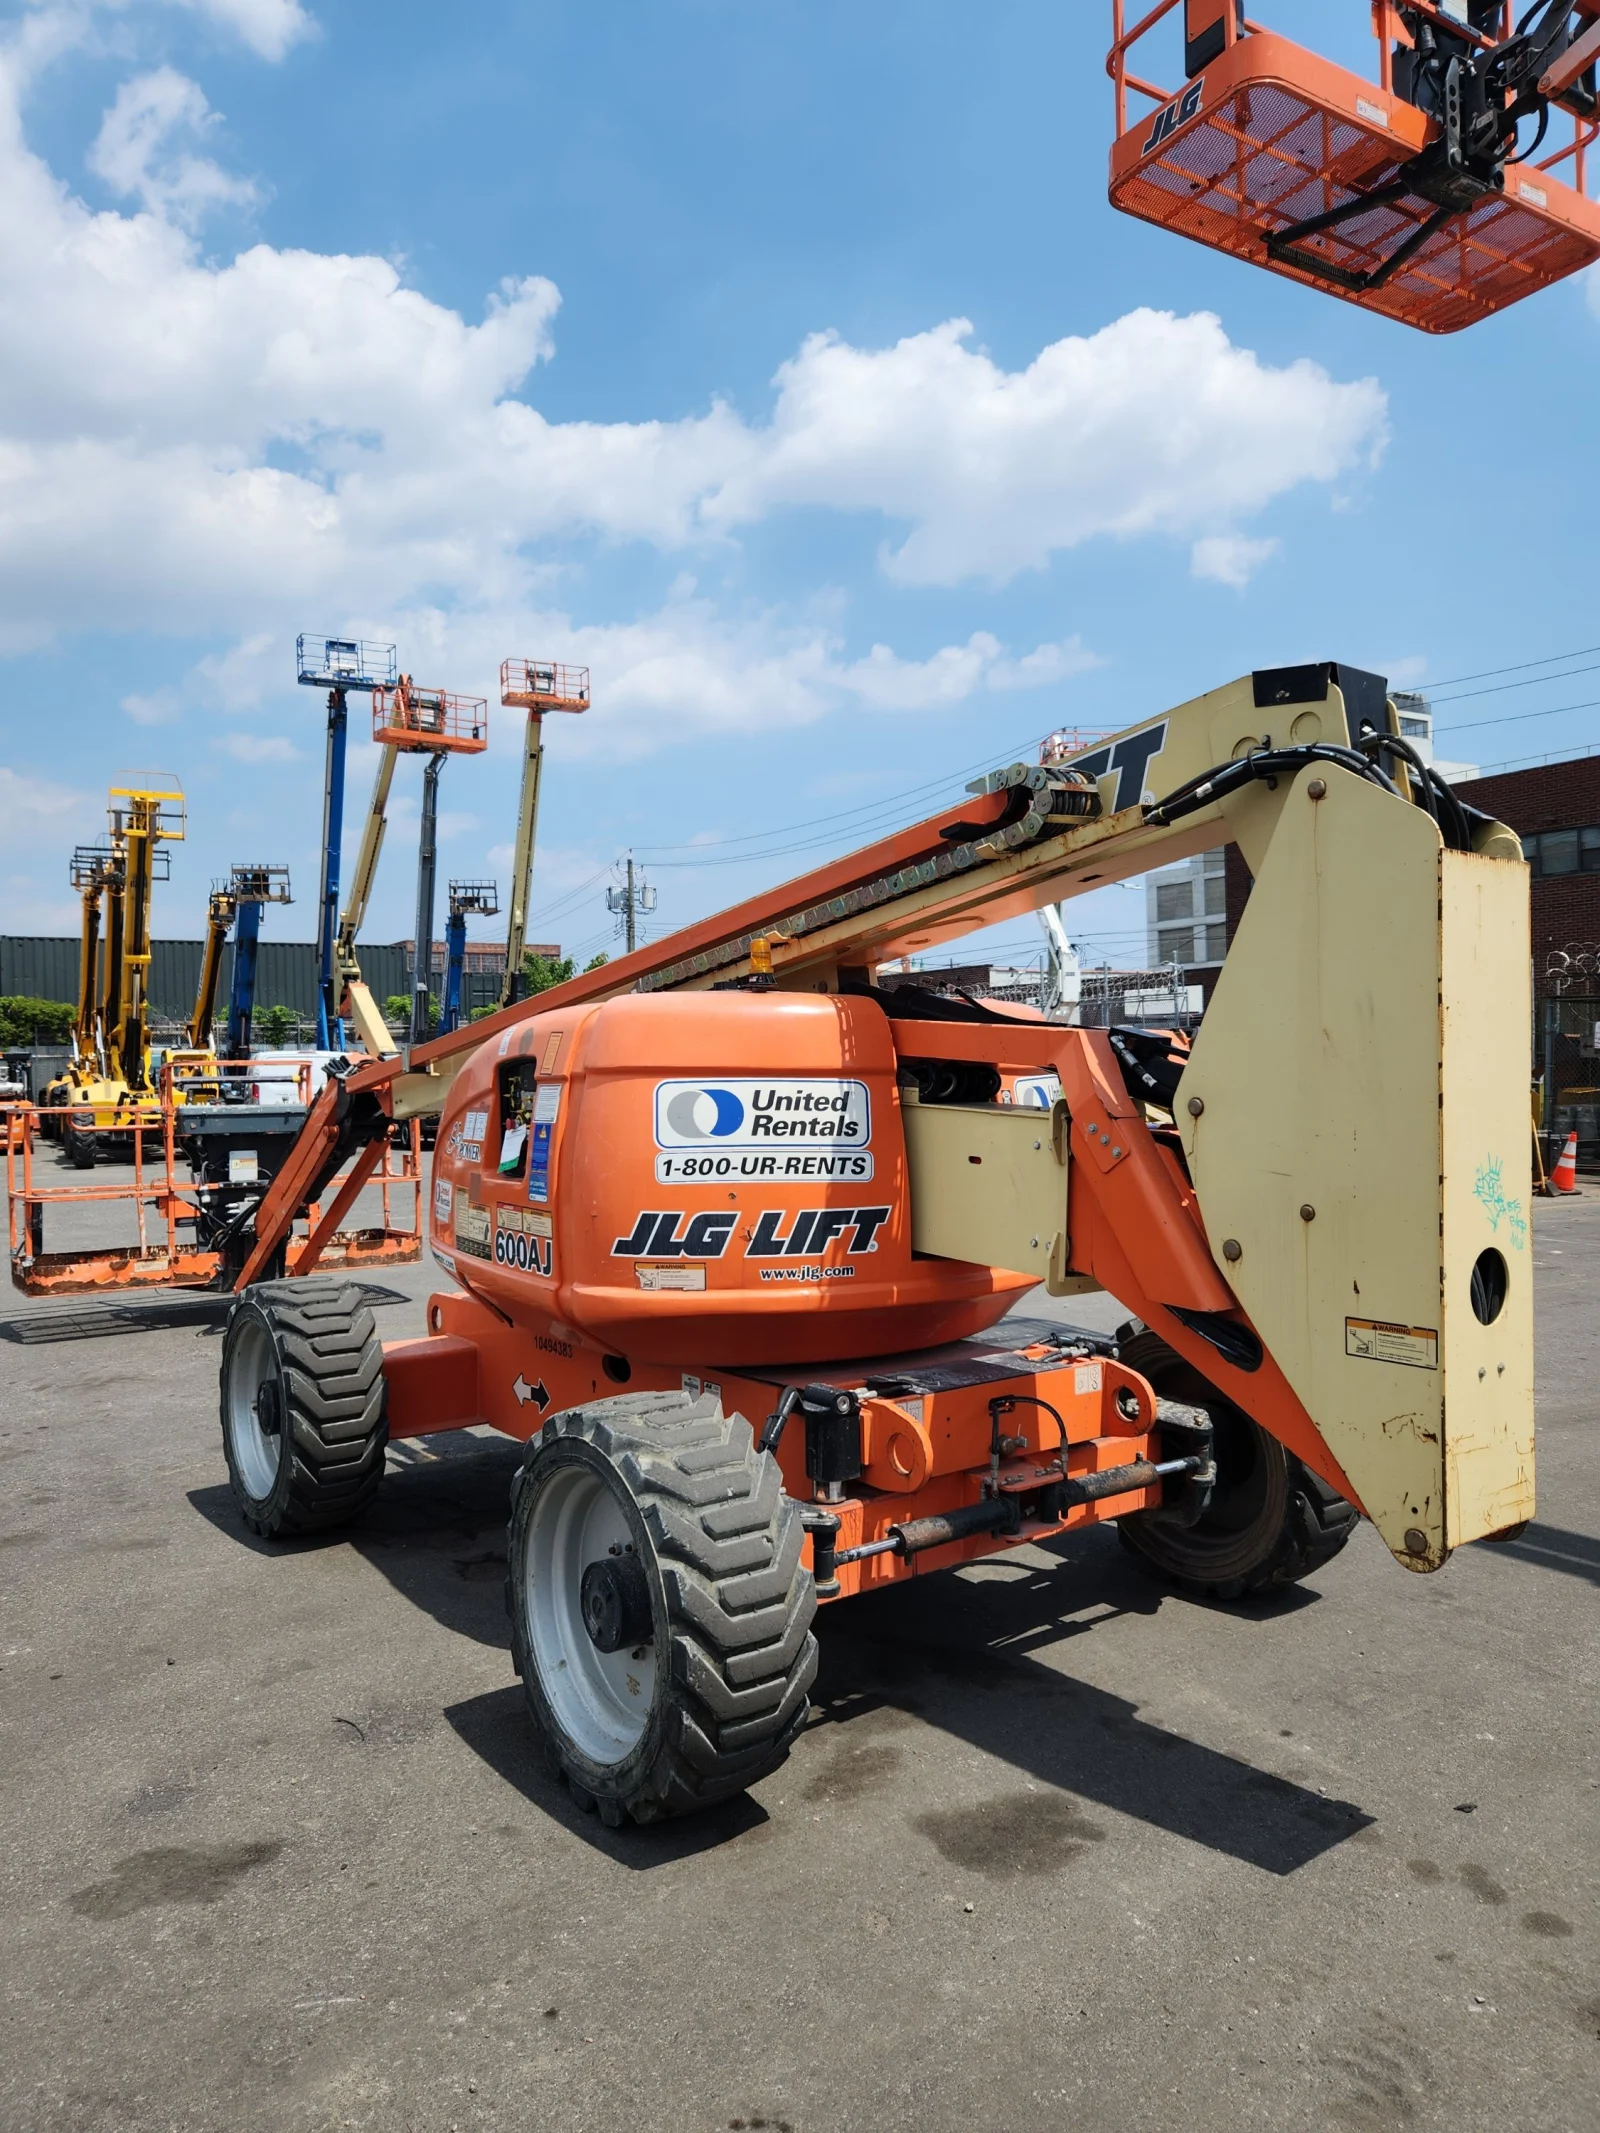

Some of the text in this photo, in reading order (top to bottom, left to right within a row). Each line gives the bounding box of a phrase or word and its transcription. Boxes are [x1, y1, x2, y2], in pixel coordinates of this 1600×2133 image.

[1141, 76, 1204, 157] JLG
[751, 1089, 850, 1112] United
[751, 1114, 859, 1137] Rentals
[457, 1142, 481, 1162] POWER
[662, 1156, 867, 1177] 1-800-UR-RENTS
[611, 1211, 742, 1258] JLG
[744, 1205, 892, 1258] LIFT
[495, 1228, 552, 1277] 600AJ
[760, 1266, 855, 1282] www.jlg.com
[1377, 1324, 1411, 1335] WARNING
[534, 1335, 573, 1358] 10494383
